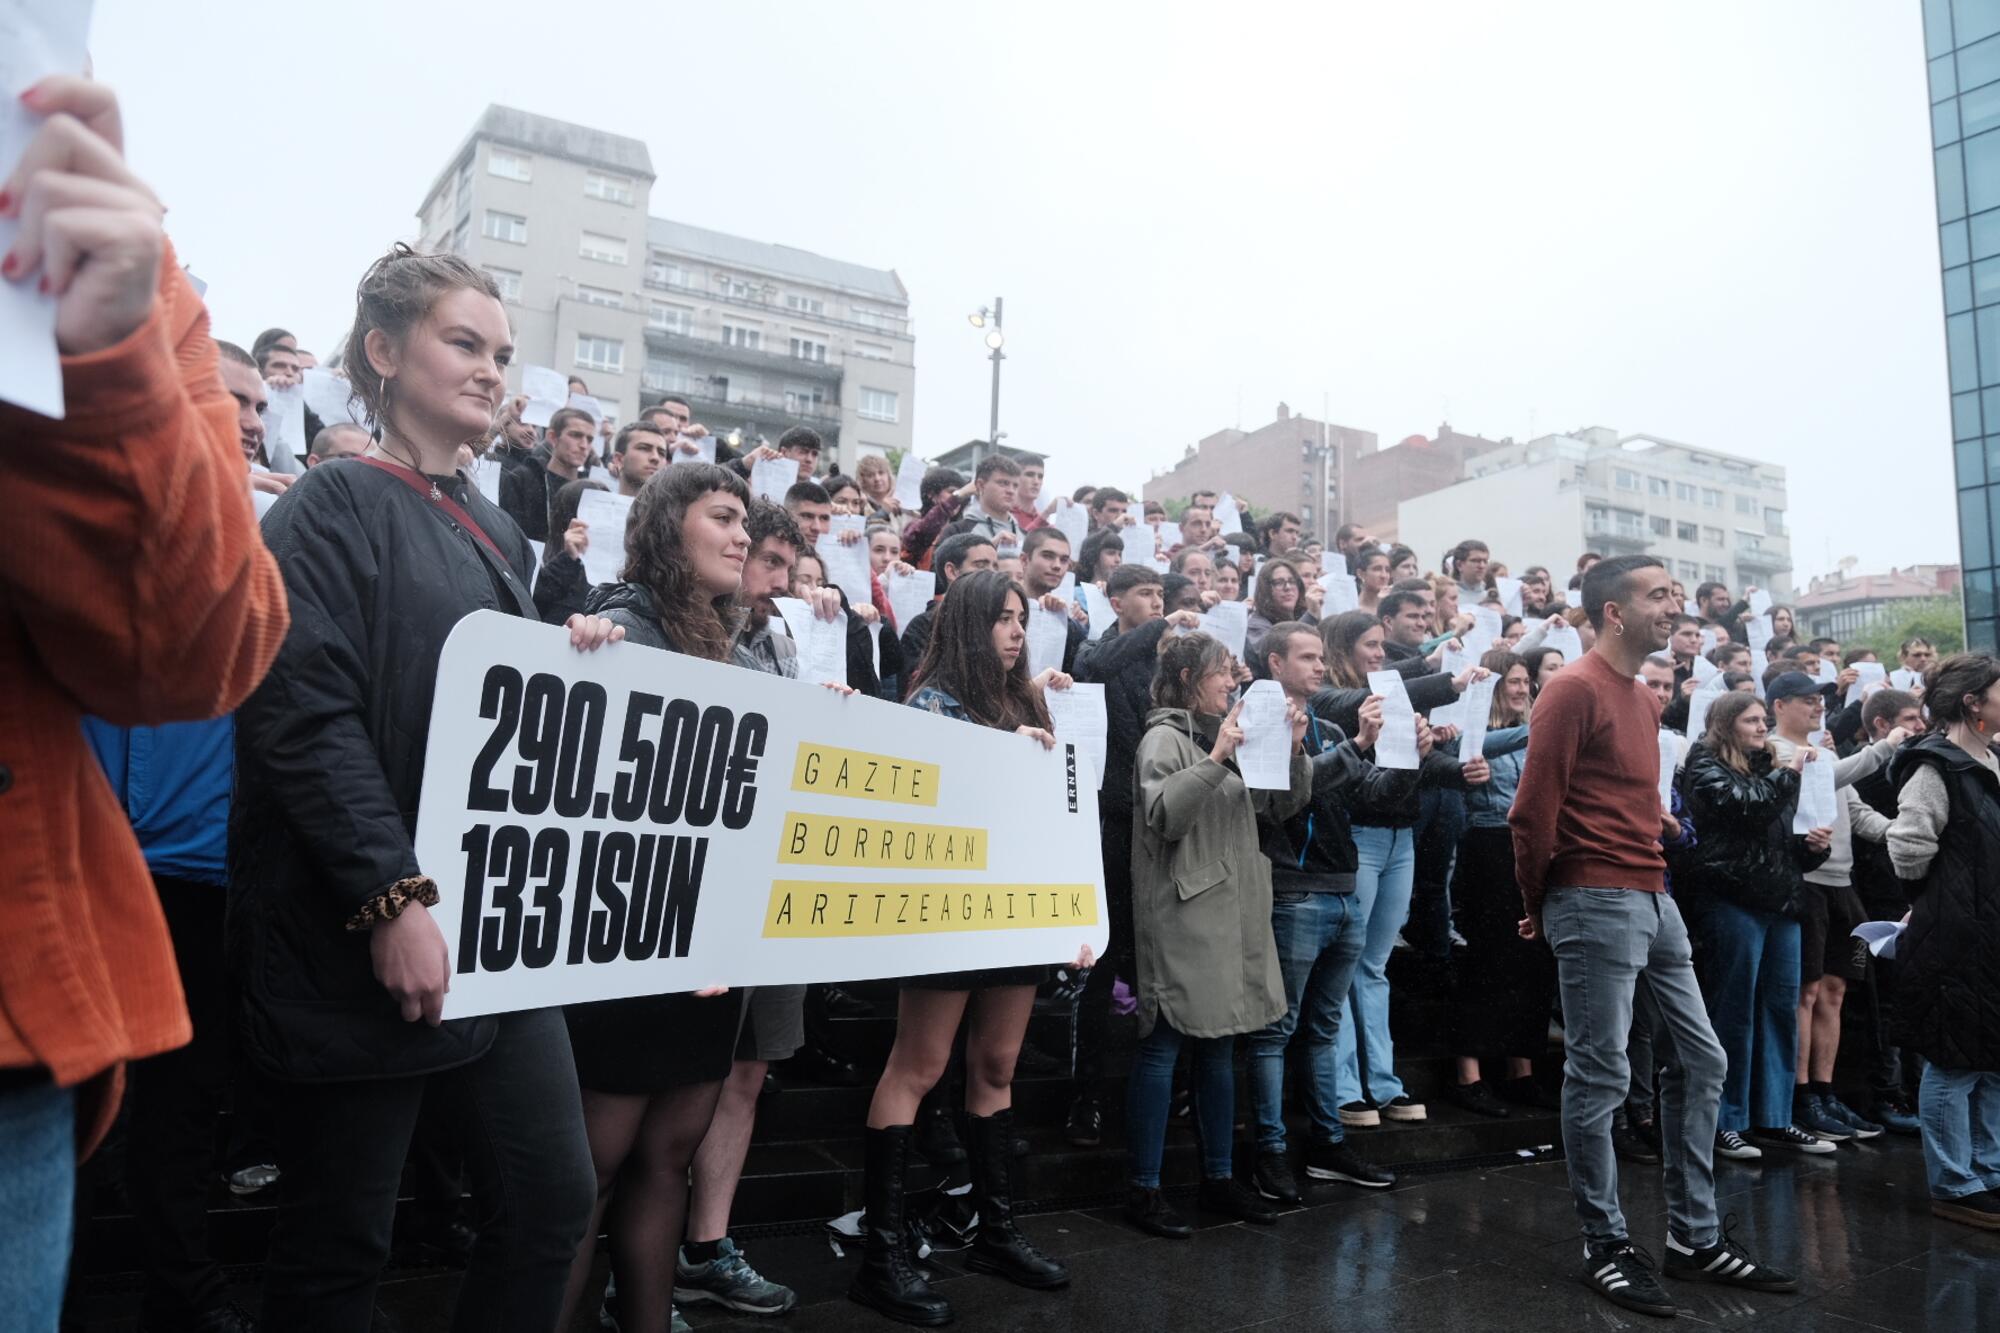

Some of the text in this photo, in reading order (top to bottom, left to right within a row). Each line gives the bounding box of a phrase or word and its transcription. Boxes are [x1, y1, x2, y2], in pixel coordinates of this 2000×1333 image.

[467, 665, 769, 830] 290.500€
[804, 752, 922, 797] GAZTE
[1067, 752, 1077, 809] ERNAI
[790, 822, 976, 862] BORROKAN
[457, 824, 709, 974] 133 ISUN
[776, 892, 1083, 925] ARITZEAGAITIK
